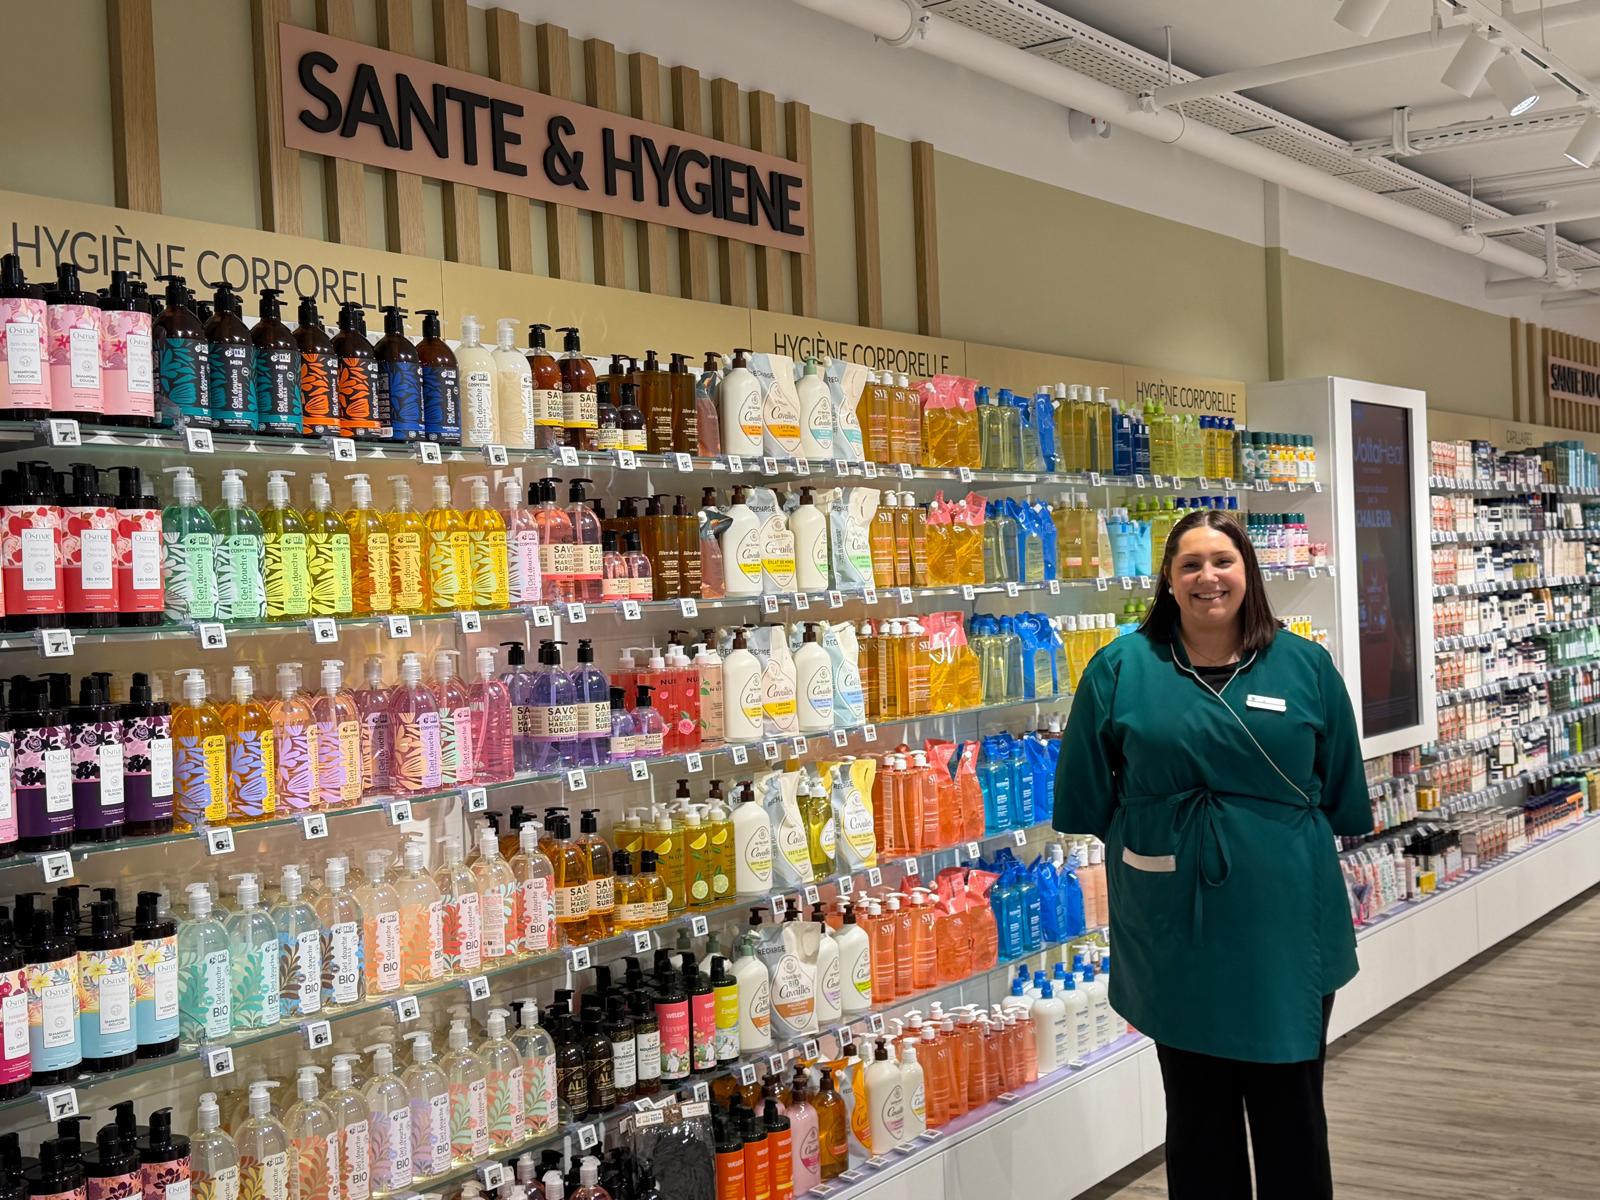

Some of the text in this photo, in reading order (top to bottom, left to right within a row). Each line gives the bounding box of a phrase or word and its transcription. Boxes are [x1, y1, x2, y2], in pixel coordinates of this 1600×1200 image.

[297, 51, 805, 237] SANTE & HYGIENE
[11, 222, 408, 313] HYGIÈNE CORPORELLE
[774, 331, 950, 378] HYGIÈNE CORPORELLE
[1136, 379, 1237, 413] HYGIÈNE CORPORELLE
[749, 505, 776, 513] RECHARGE
[195, 553, 203, 584] douche
[530, 923, 545, 933] BIO
[466, 940, 479, 950] BIO
[758, 945, 786, 955] RECHARGE
[383, 962, 398, 972] BIO
[338, 973, 355, 985] BIO
[305, 984, 319, 994] BIO
[213, 1006, 228, 1018] BIO
[476, 1128, 487, 1138] BIO
[437, 1142, 449, 1154] BIO
[396, 1158, 409, 1170] BIO
[353, 1172, 367, 1184] BIO
